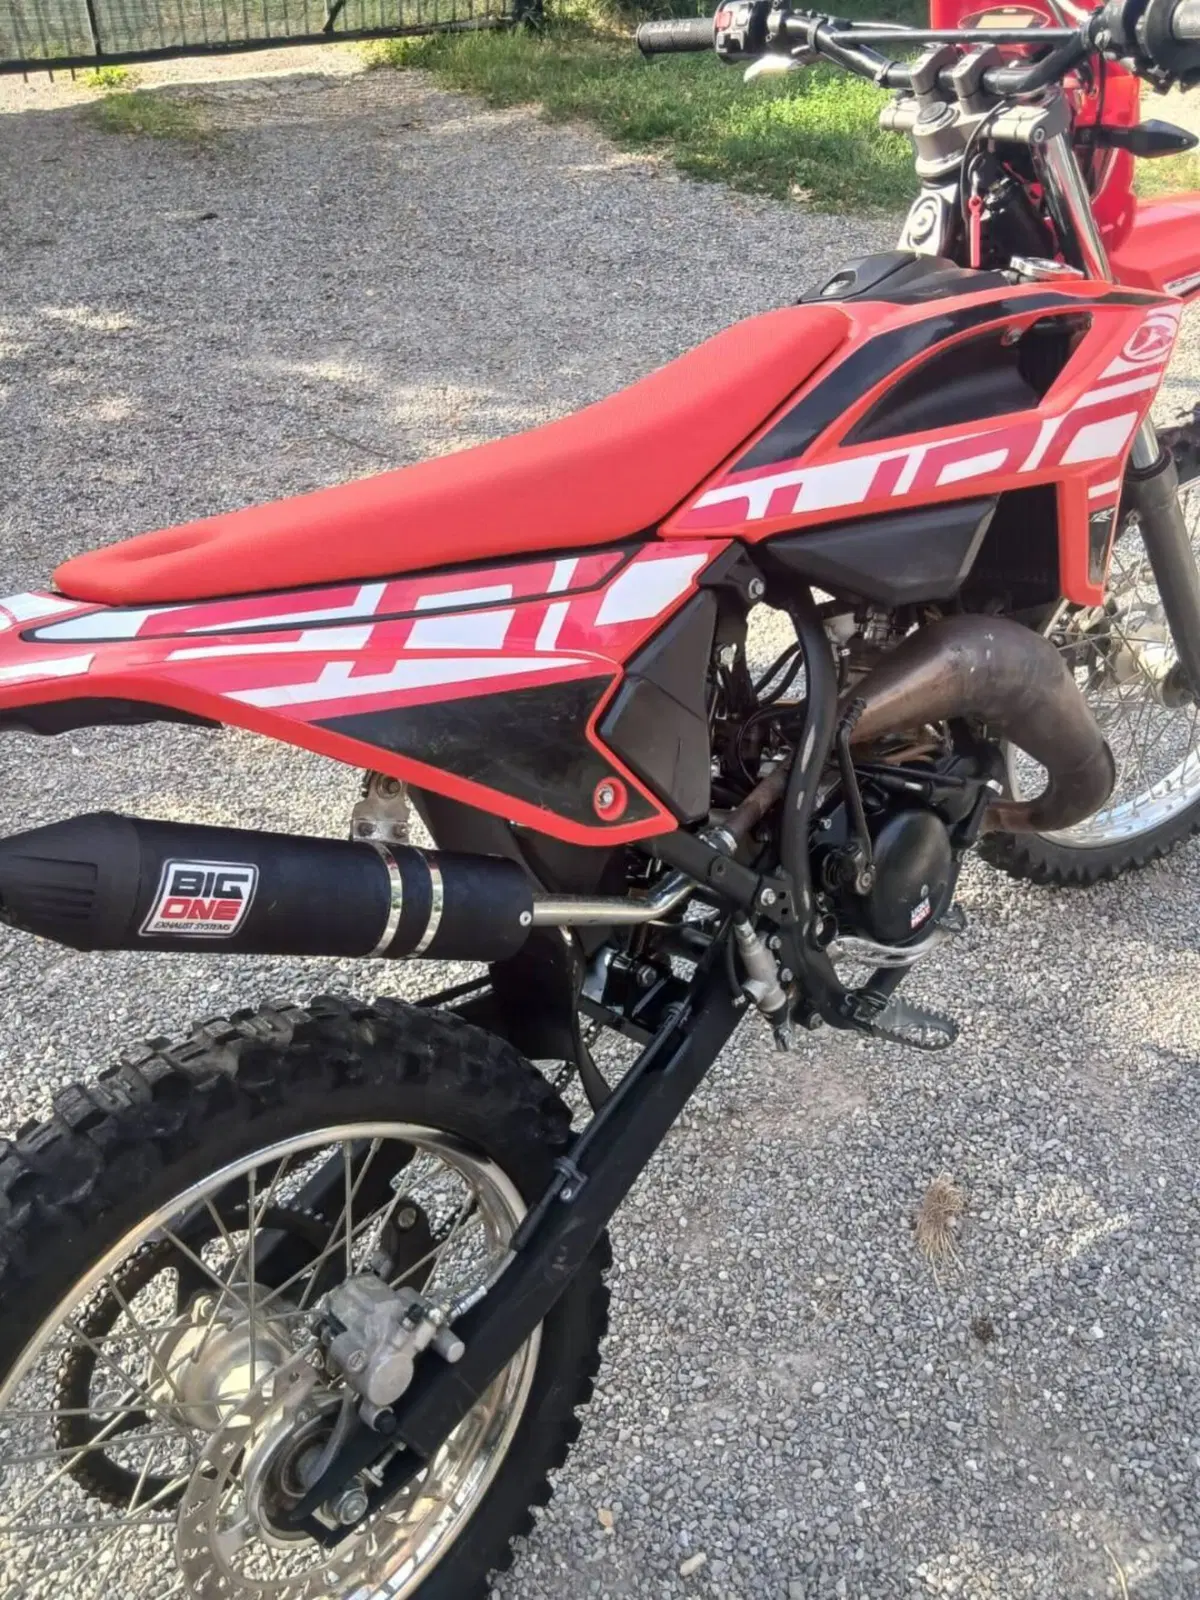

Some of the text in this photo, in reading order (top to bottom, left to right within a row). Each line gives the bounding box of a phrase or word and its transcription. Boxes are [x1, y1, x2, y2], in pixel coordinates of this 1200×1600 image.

[169, 870, 249, 900] BIG
[160, 898, 242, 921] ONE
[154, 921, 232, 931] EXHAUST SYSTEMS
